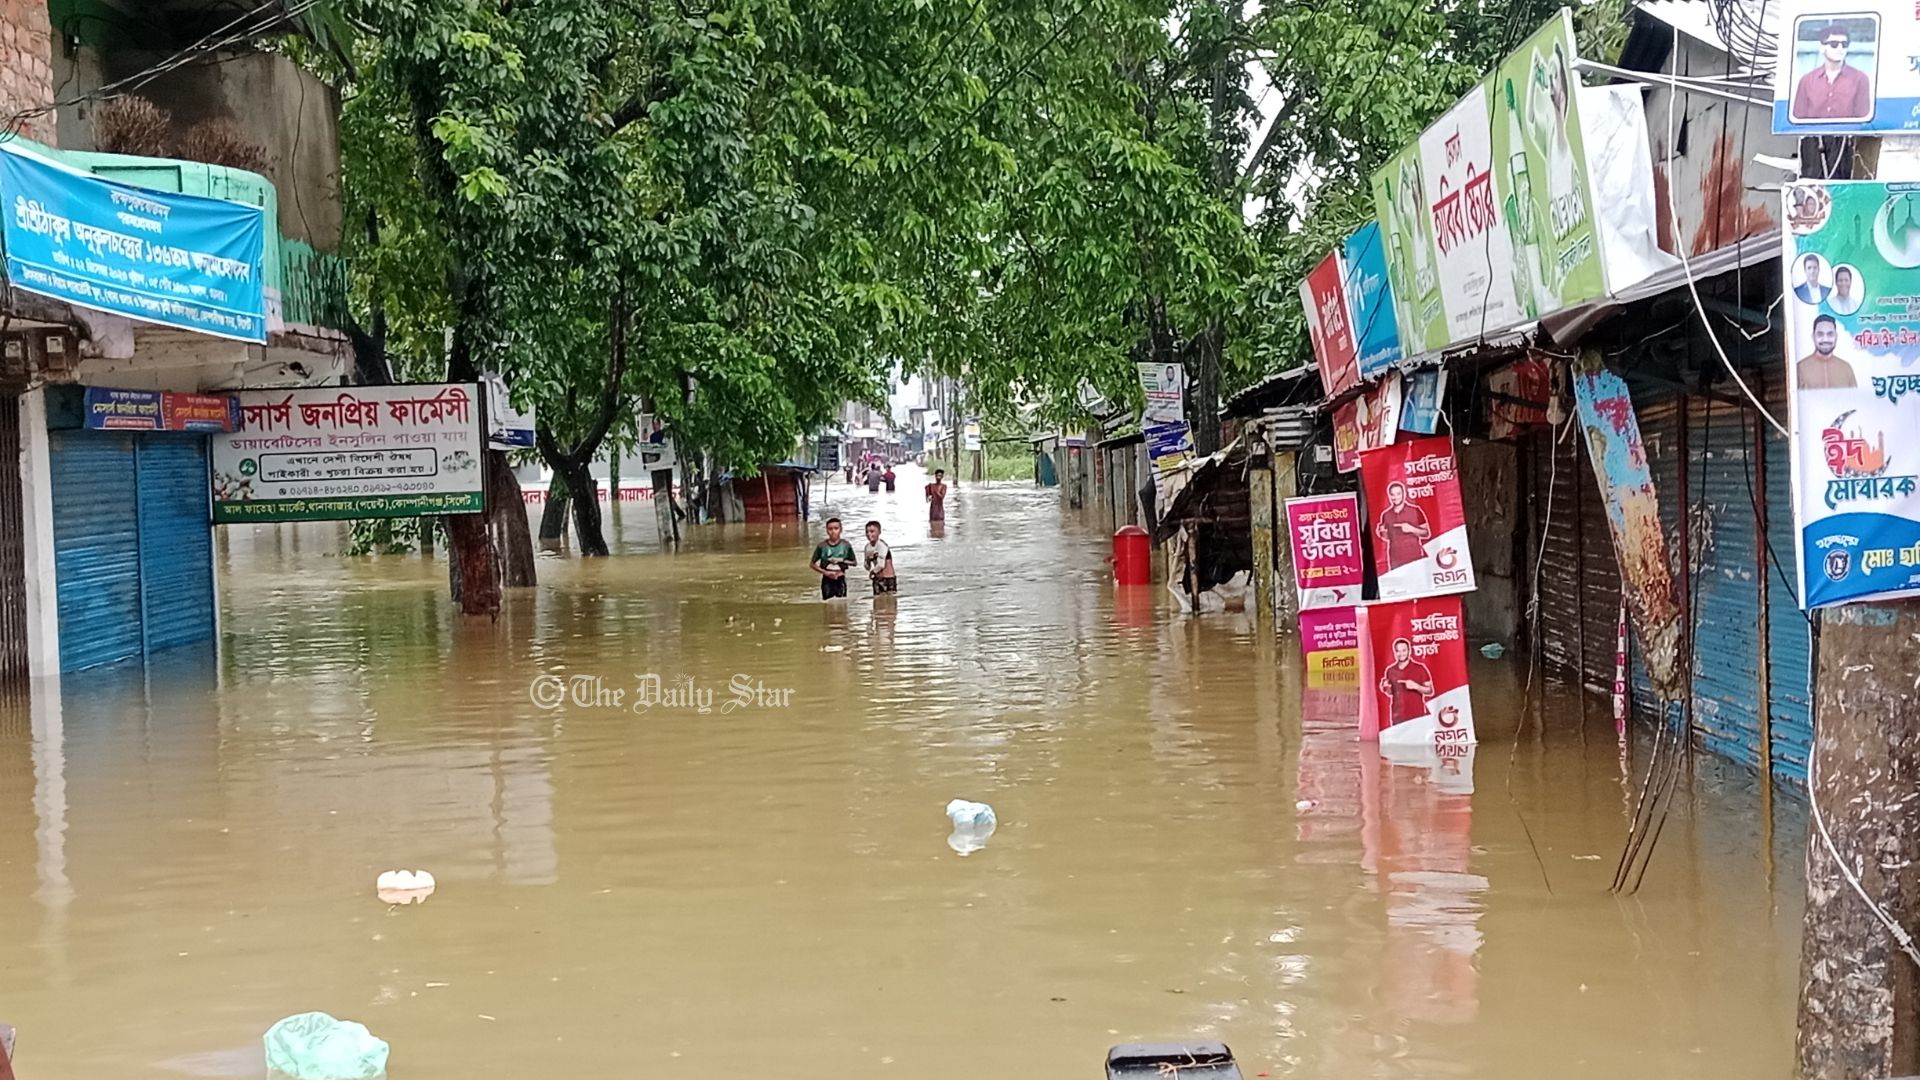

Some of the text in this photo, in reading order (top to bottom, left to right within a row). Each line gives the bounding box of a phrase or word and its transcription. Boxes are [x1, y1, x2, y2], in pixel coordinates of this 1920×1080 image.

[1881, 328, 1895, 348] ঈদ
[298, 393, 380, 430] জনপ্রিয়
[386, 388, 471, 426] ফার্মেসী
[231, 430, 467, 451] ডায়াবেটিসের ইনসুলিন পাওয়া যায়
[1822, 428, 1864, 476] ঈদ
[1407, 483, 1436, 499] চার্জ
[1824, 475, 1918, 509] মোবারক
[1297, 518, 1351, 545] সুবিধা
[1300, 539, 1352, 560] ডাবল
[1861, 549, 1894, 576] মোঃ
[1432, 568, 1467, 585] নগদ
[1410, 612, 1458, 632] সর্বনিম্ন
[1411, 641, 1440, 659] চার্জ
